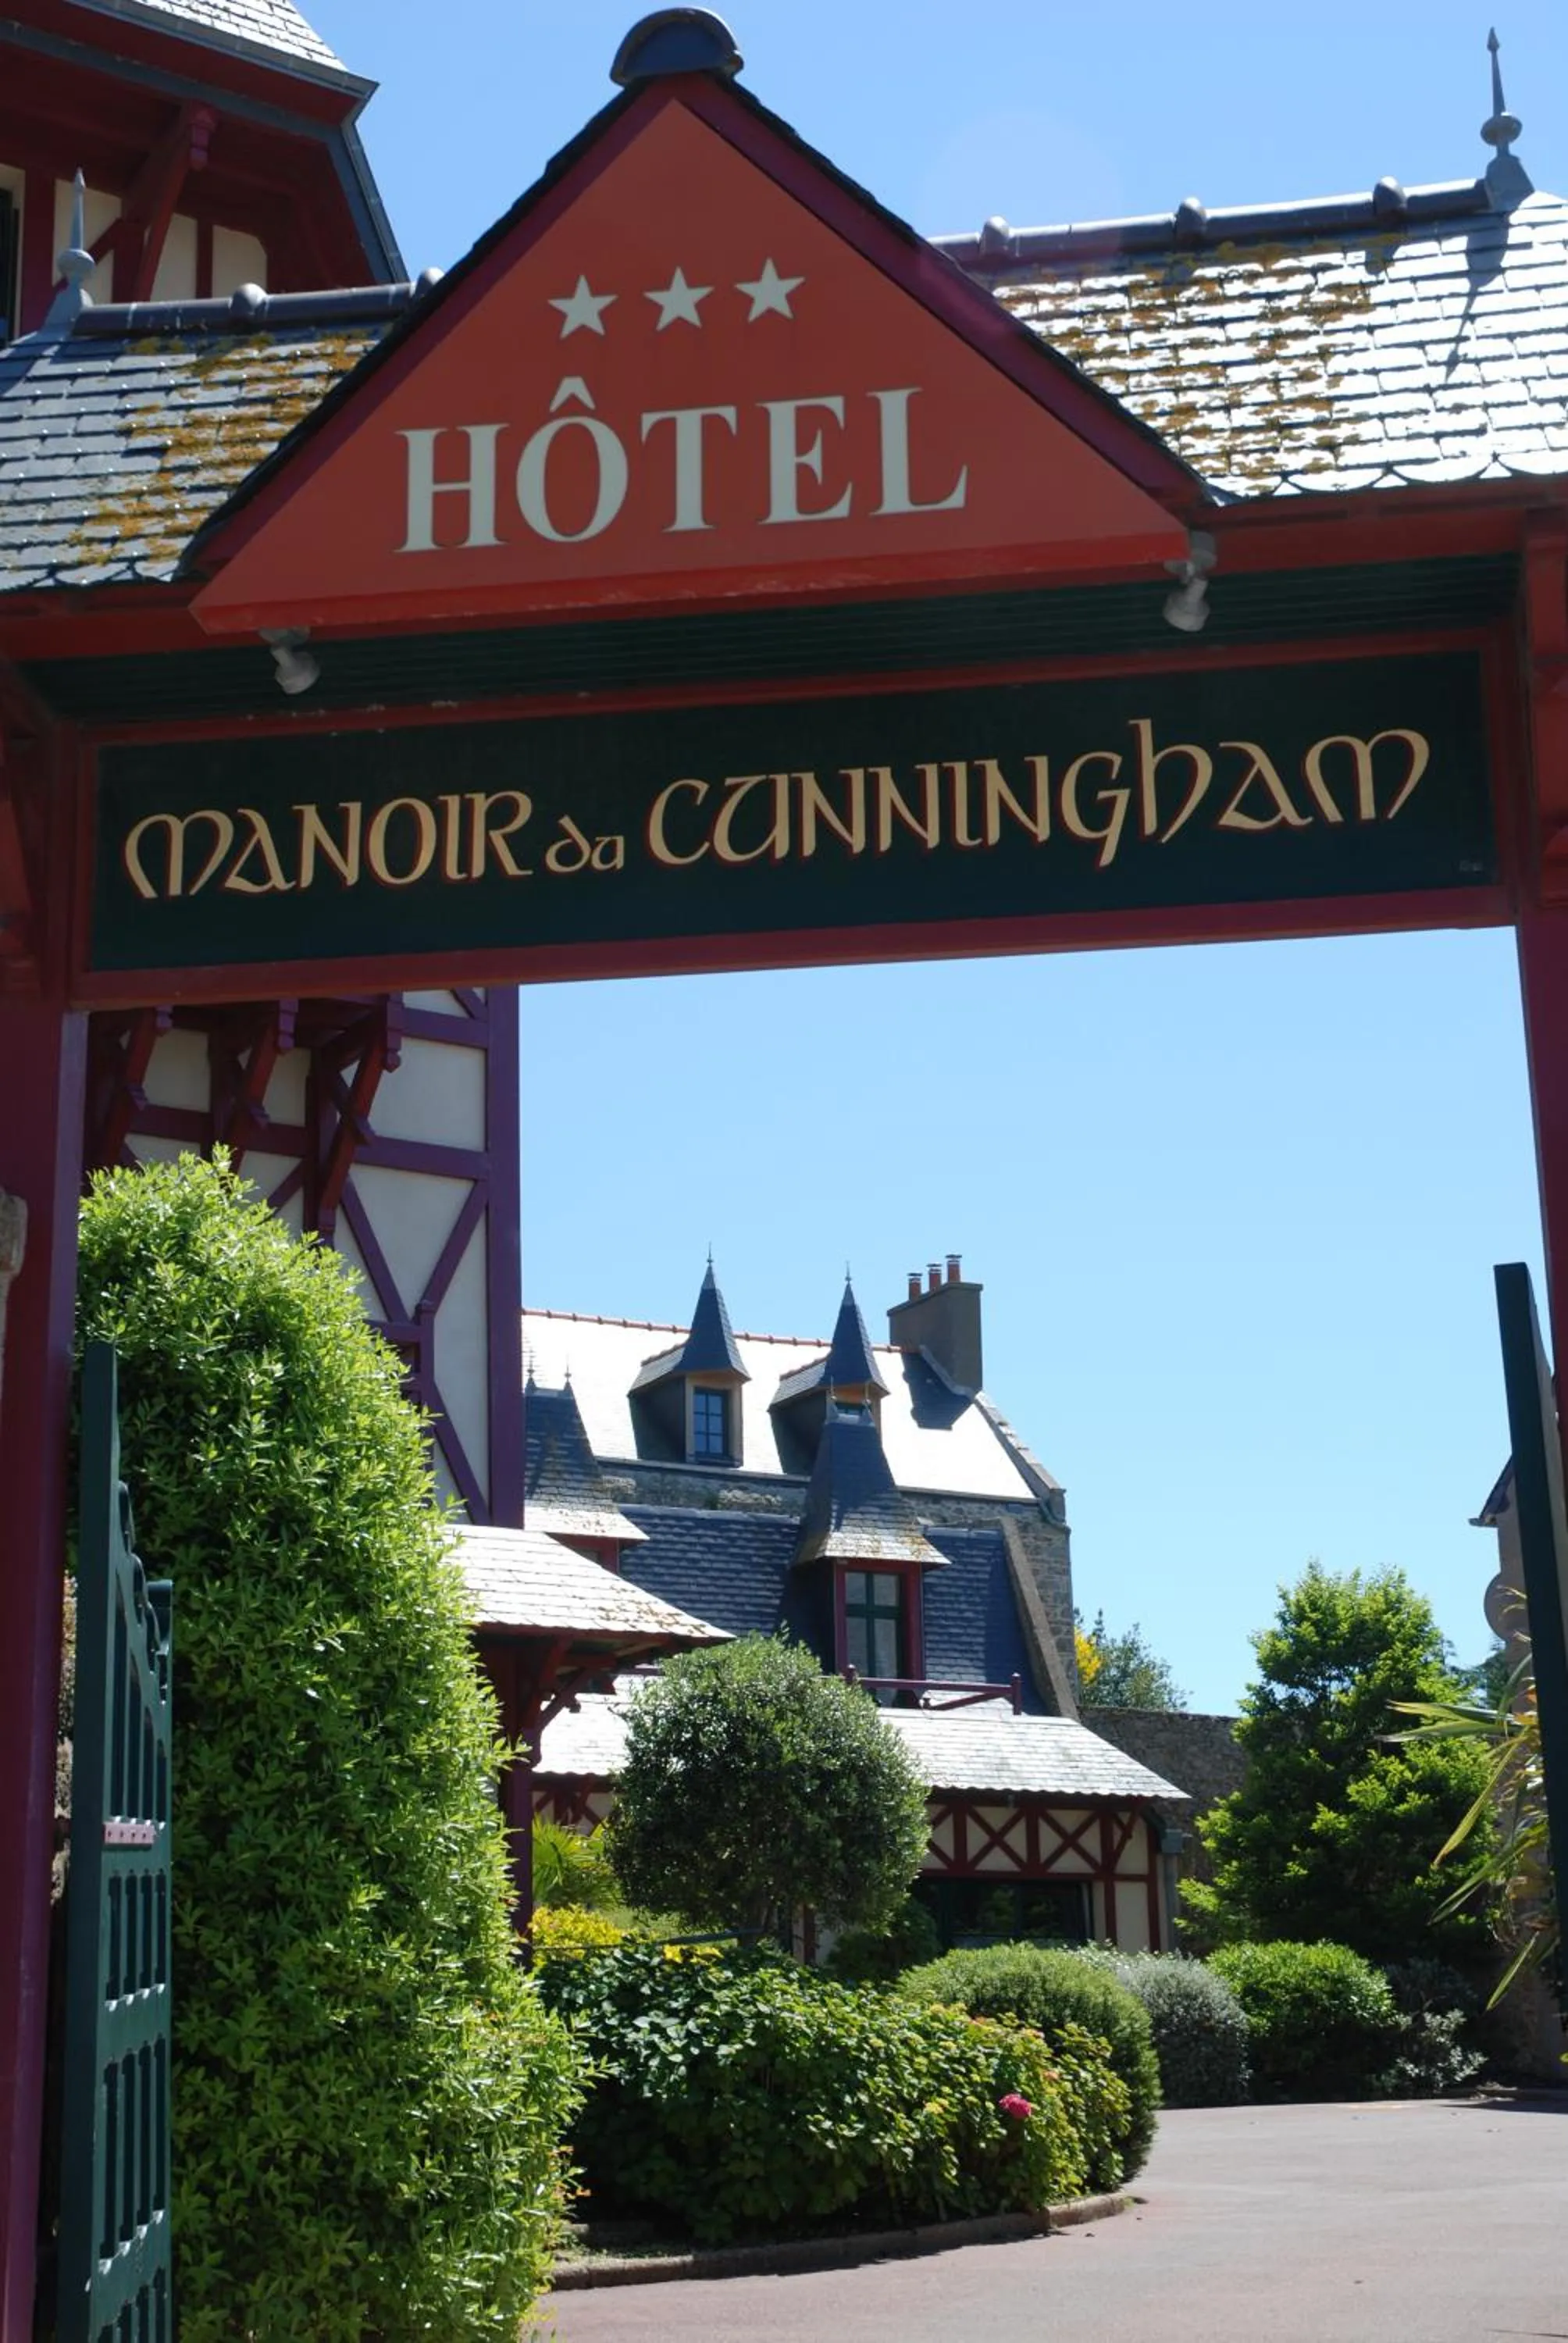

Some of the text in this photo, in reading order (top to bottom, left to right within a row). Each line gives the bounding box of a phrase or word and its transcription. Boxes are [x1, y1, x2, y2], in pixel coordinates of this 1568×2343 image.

[394, 376, 968, 554] HÔTEL
[125, 790, 533, 900] MANOIR
[545, 815, 625, 873] du
